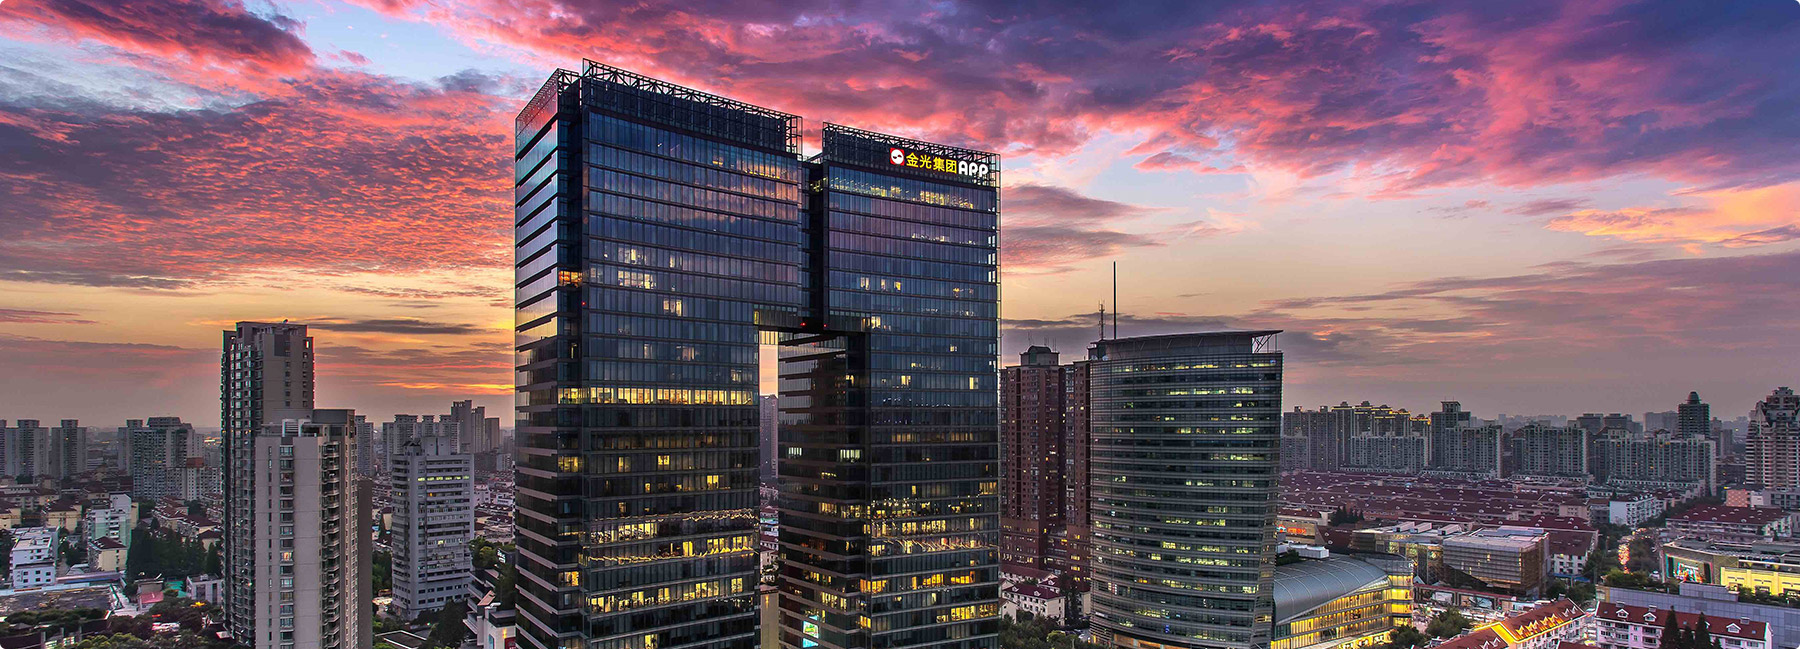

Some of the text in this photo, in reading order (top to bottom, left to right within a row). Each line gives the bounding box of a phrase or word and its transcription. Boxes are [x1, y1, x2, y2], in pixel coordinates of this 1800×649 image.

[906, 152, 989, 178] 金光集团 APP
